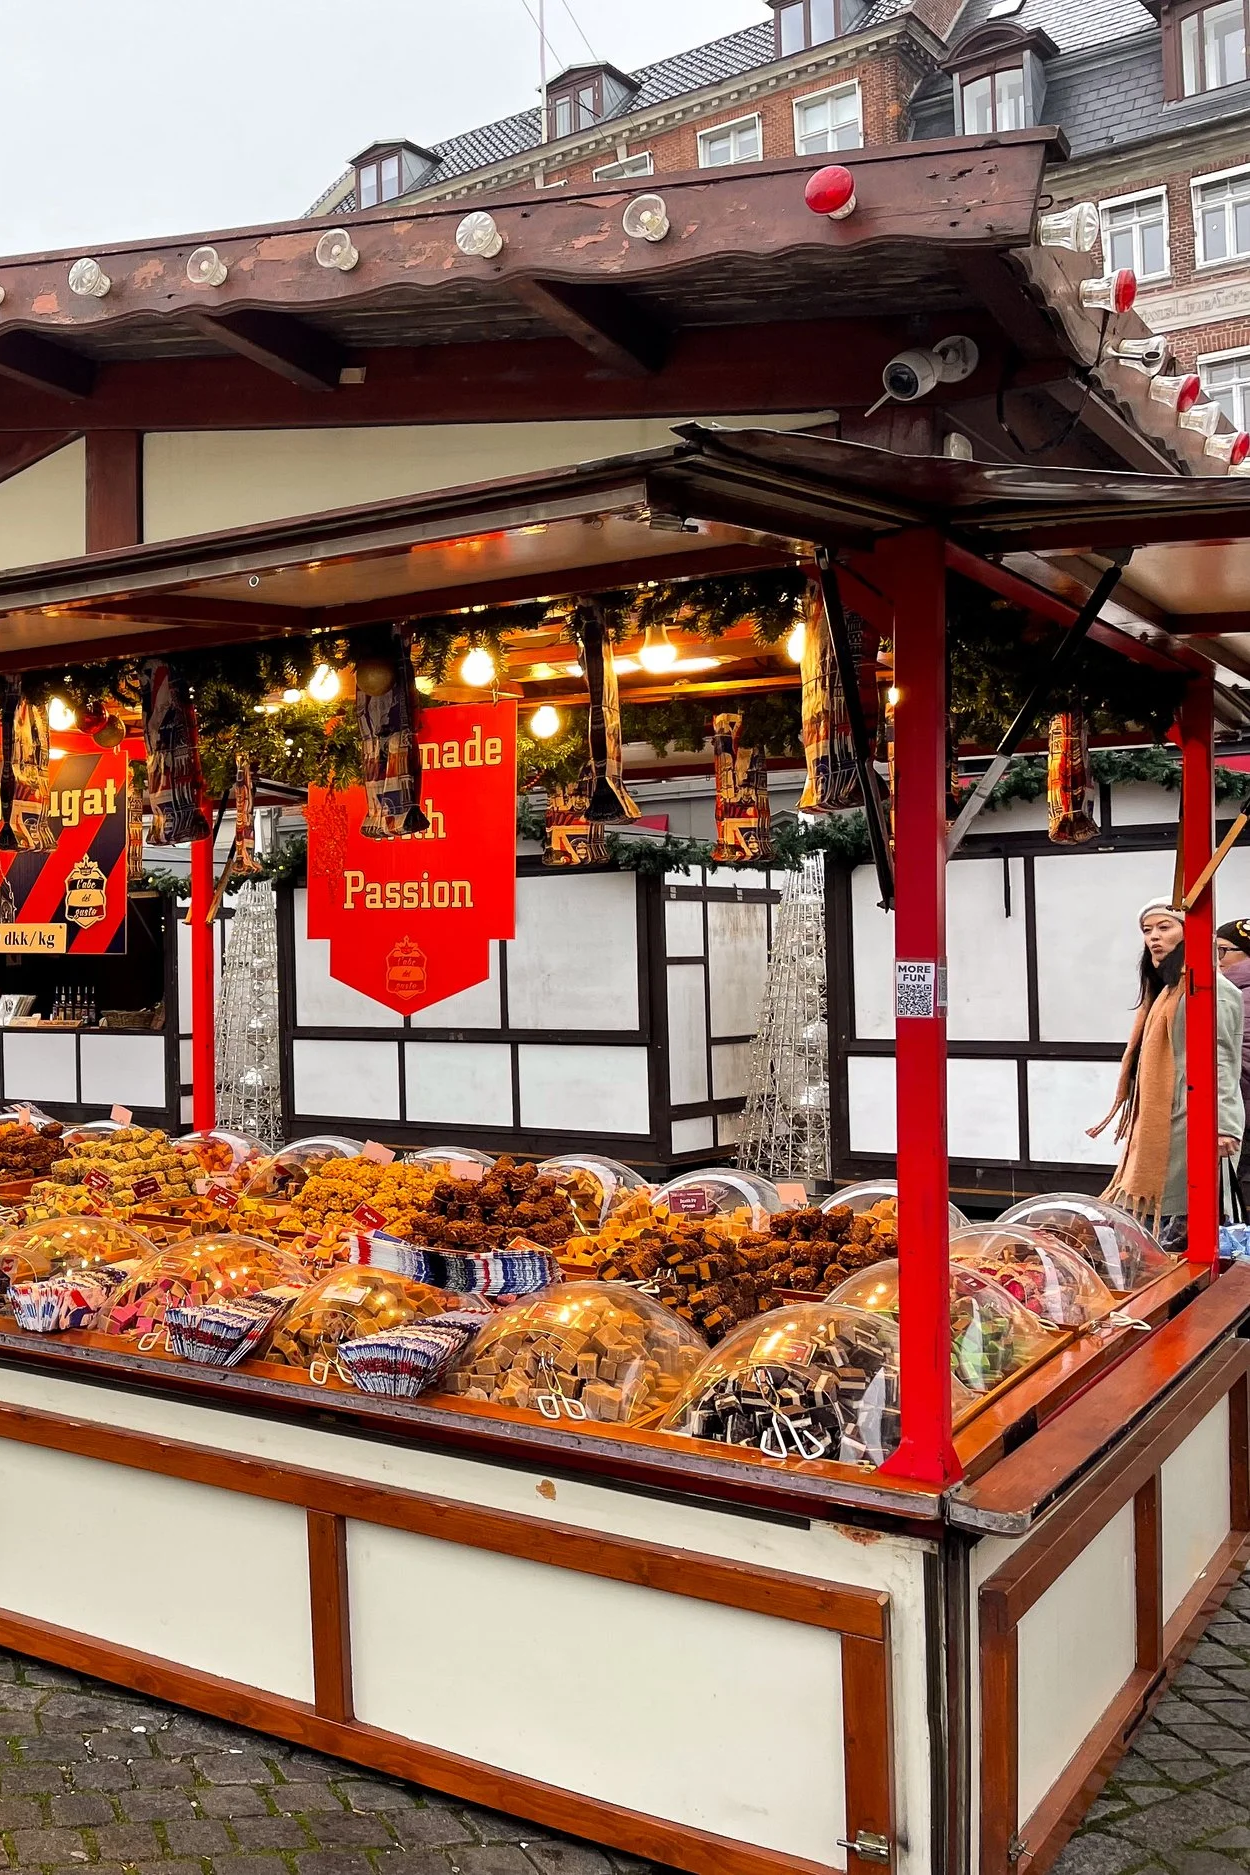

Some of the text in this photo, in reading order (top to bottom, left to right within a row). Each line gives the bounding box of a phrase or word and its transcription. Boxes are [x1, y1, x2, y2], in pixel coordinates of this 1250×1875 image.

[342, 870, 474, 910] Passion
[74, 907, 98, 919] gusto
[4, 931, 55, 949] dkk/kg
[897, 965, 931, 974] MORE
[902, 973, 926, 982] FUN
